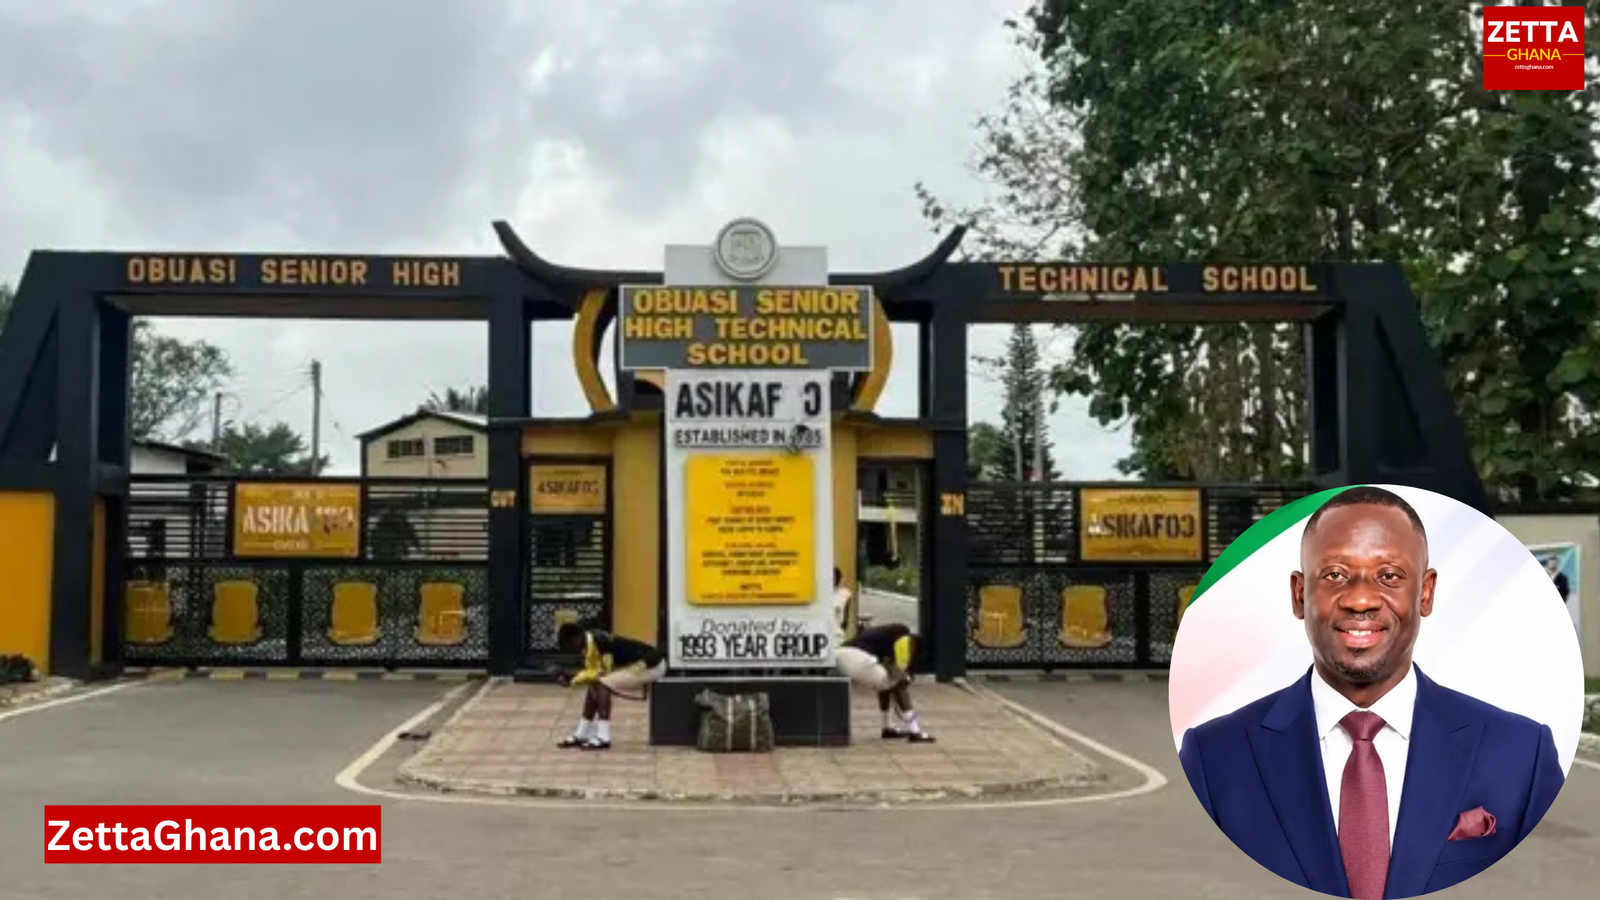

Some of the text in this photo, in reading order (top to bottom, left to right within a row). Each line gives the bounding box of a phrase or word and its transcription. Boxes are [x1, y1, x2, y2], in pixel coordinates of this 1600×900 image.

[127, 258, 460, 286] OBUASI SENIOR HIGH
[998, 266, 1318, 292] TECHNICAL SCHOOL
[633, 288, 860, 315] OBUASI SENIOR
[624, 317, 868, 339] HIGH TECHNICAL
[687, 343, 808, 365] SCHOOL
[675, 429, 769, 444] ESTABLISHED
[772, 429, 786, 444] IN
[940, 493, 965, 515] IN
[702, 618, 777, 634] Donated
[680, 633, 829, 658] 1993 YEAR GROUP
